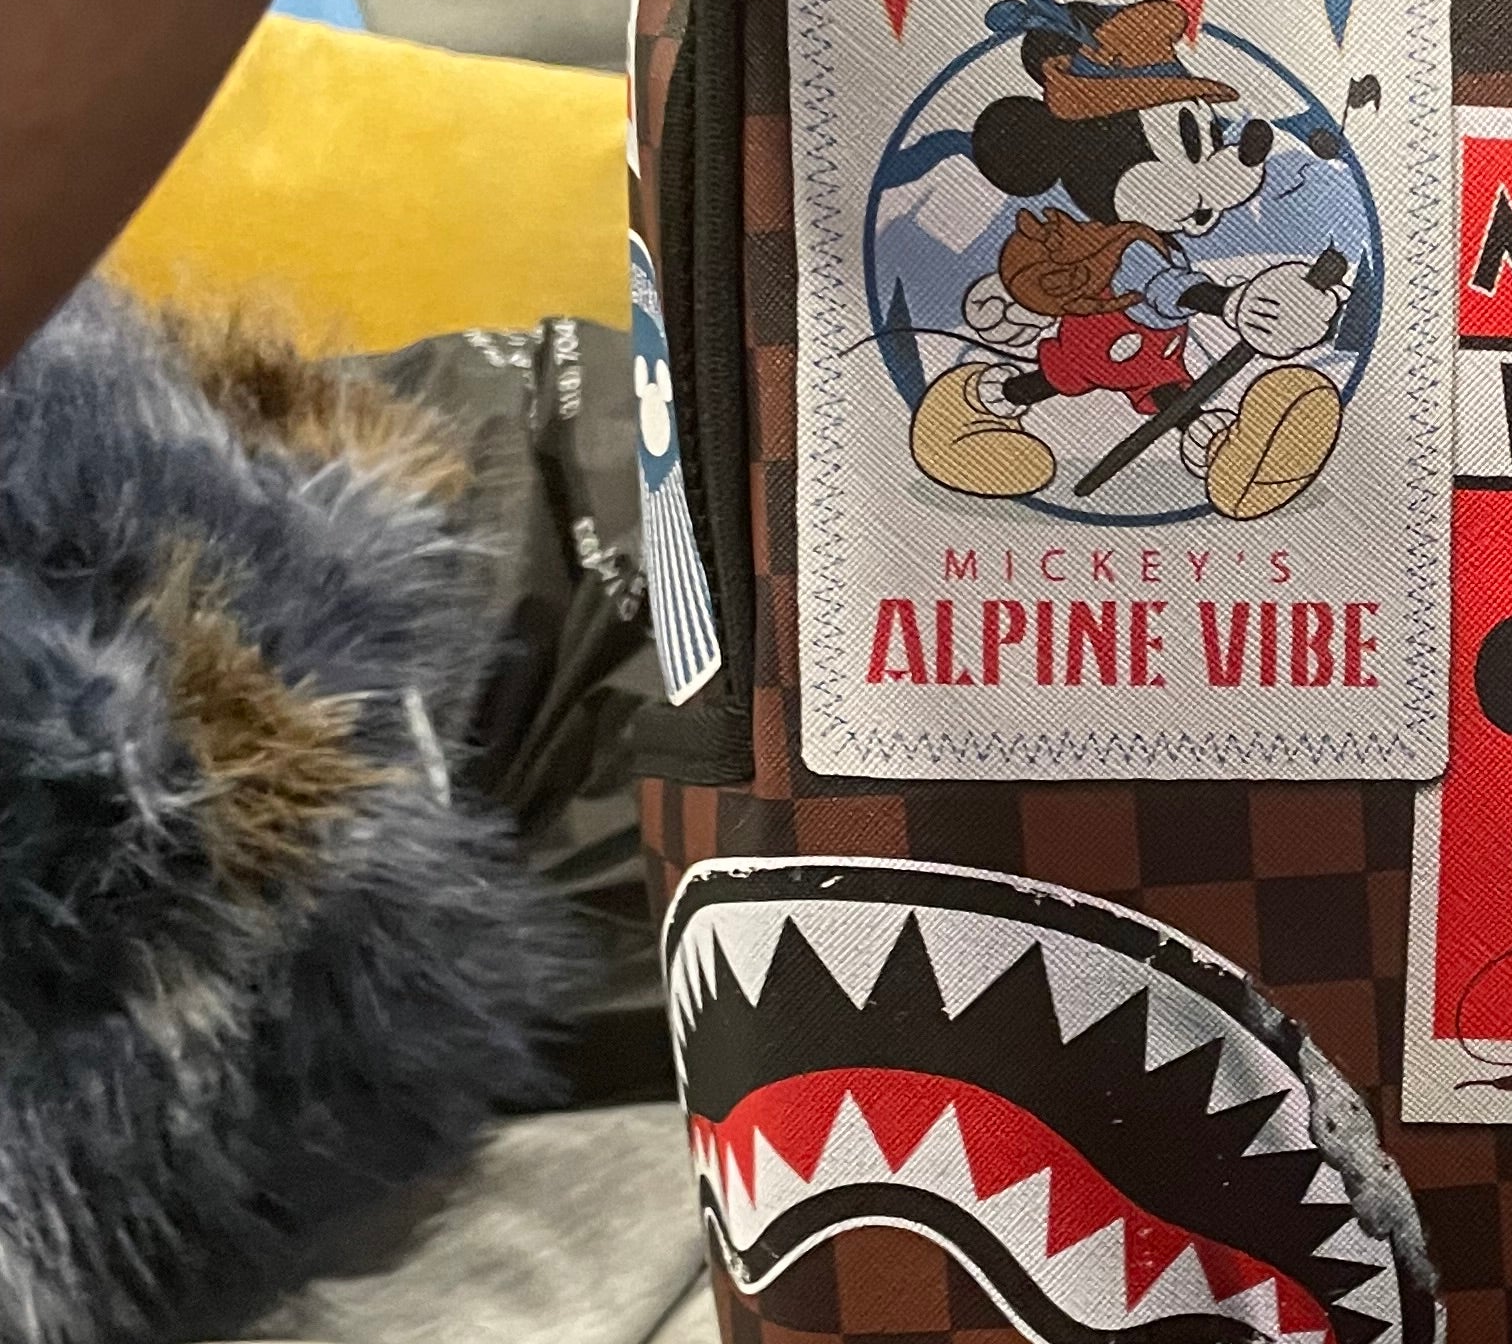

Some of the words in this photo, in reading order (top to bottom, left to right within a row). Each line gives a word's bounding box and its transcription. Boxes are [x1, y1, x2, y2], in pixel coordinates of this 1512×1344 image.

[941, 548, 1294, 584] MICKEY'S
[864, 597, 1170, 690] ALPINE
[1199, 600, 1382, 690] VIBE
